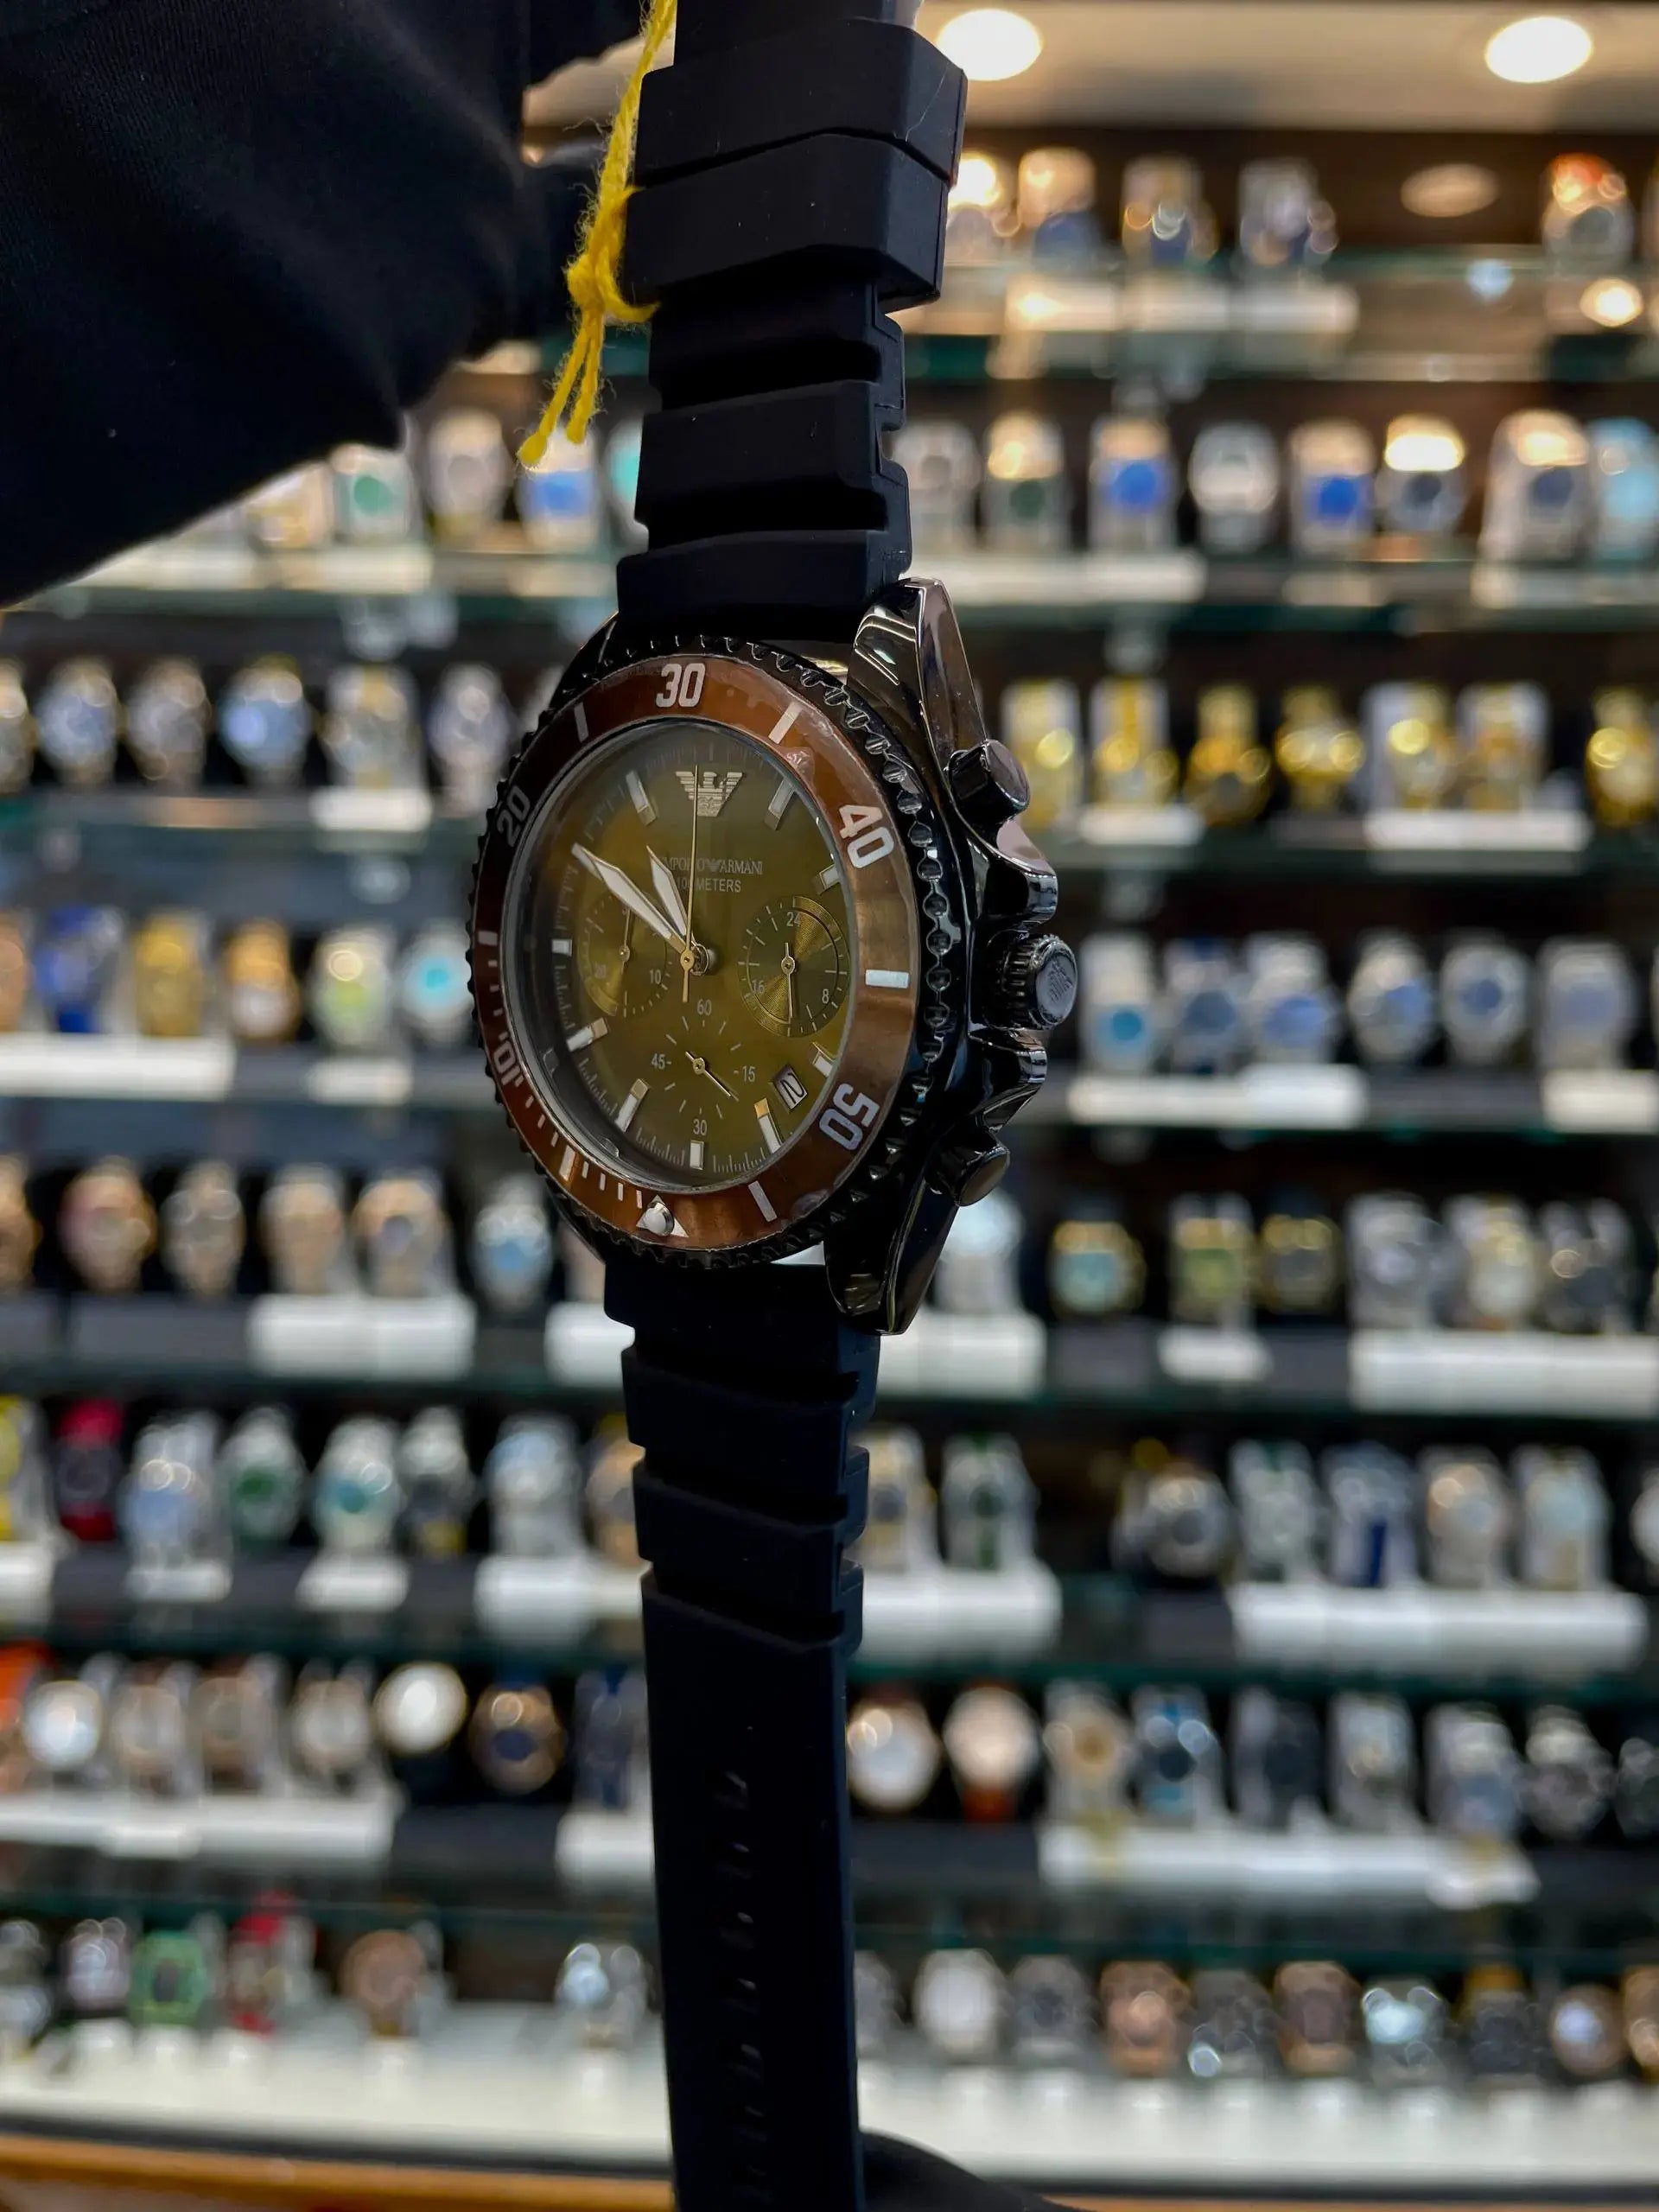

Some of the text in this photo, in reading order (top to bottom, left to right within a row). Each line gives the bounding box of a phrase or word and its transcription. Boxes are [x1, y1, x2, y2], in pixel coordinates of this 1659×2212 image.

[656, 663, 705, 708] 30
[496, 785, 531, 847] 20
[839, 804, 894, 868] 40
[659, 856, 764, 875] MPOO ARMANI
[696, 877, 741, 893] METERS
[786, 912, 801, 927] 24
[649, 969, 662, 985] 10
[752, 979, 766, 994] 16
[821, 988, 830, 1004] 8
[696, 999, 712, 1015] 60
[493, 1040, 522, 1086] 10
[651, 1052, 665, 1070] 45
[742, 1065, 756, 1083] 15
[819, 1083, 880, 1150] 50
[693, 1119, 708, 1136] 30
